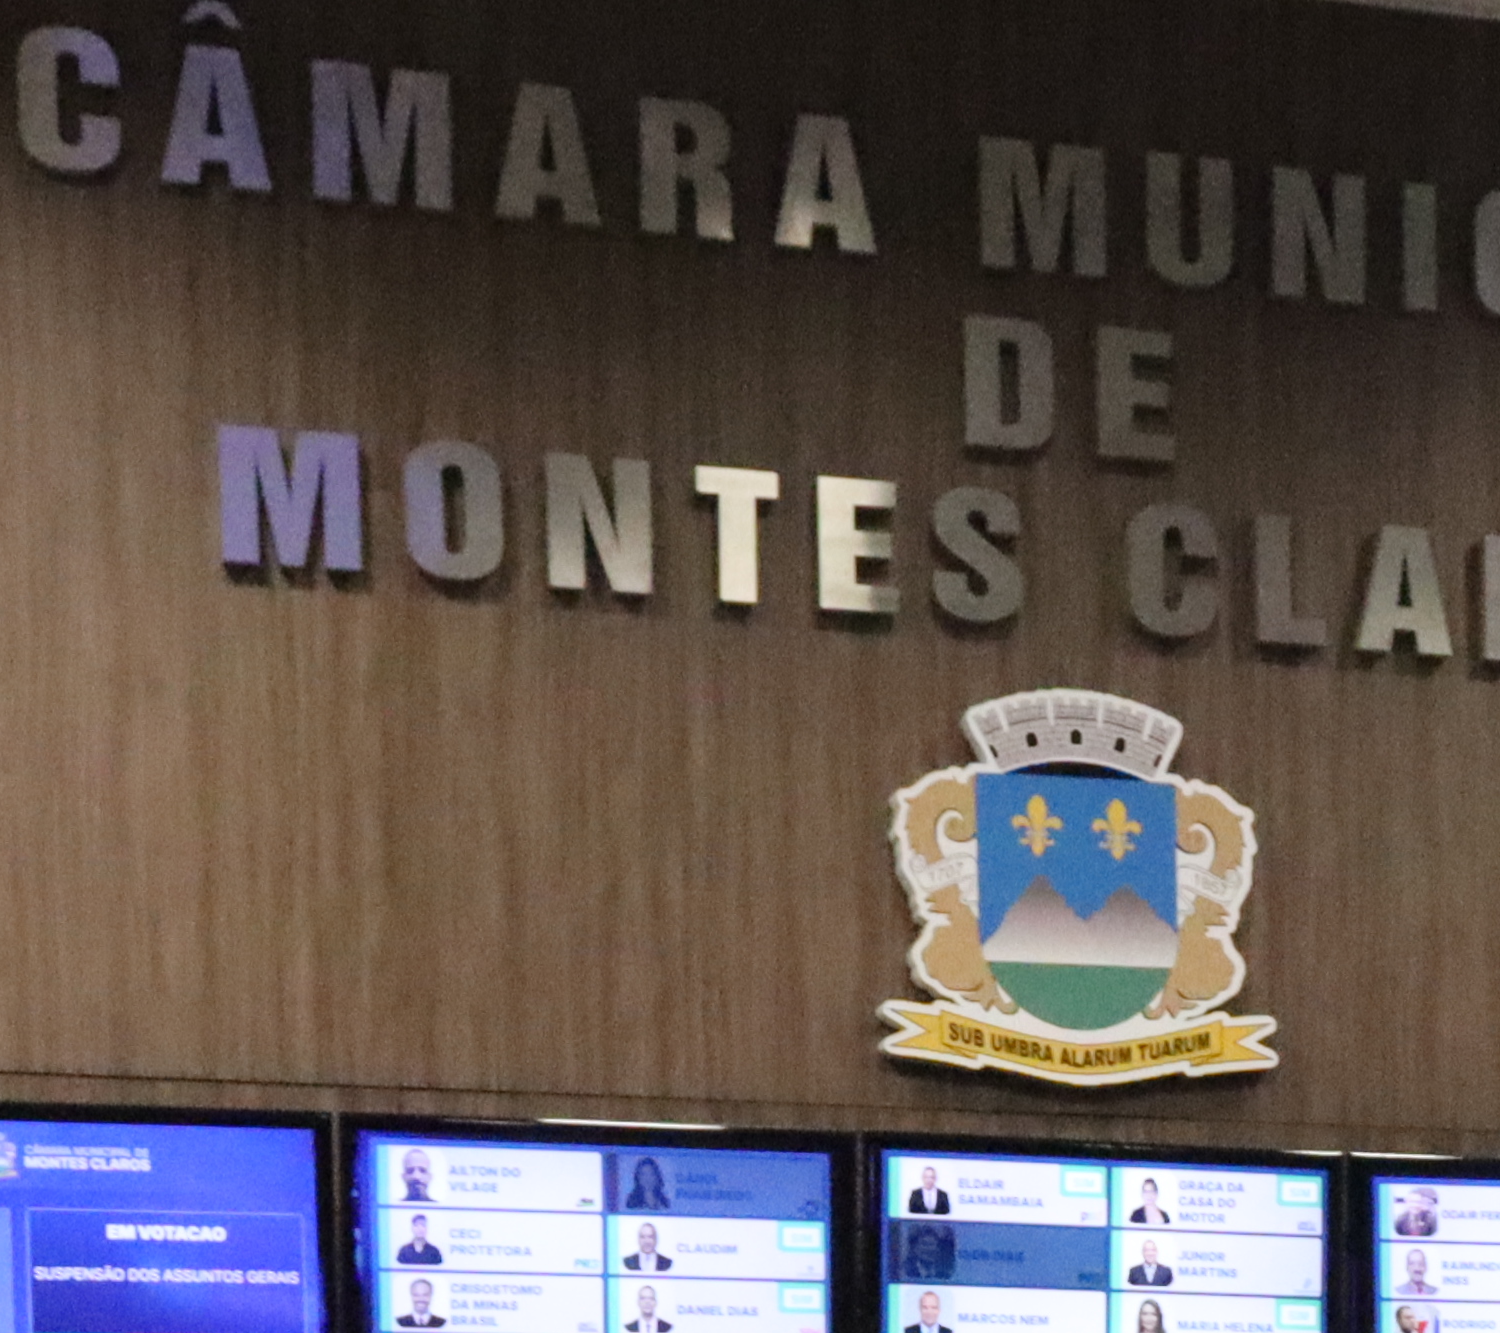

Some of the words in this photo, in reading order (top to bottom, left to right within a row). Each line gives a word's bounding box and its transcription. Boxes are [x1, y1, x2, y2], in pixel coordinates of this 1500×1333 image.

[16, 1, 878, 255] CÂMARA
[962, 314, 1176, 462] DE
[217, 424, 1023, 624] MONTES
[948, 1021, 985, 1049] SUB
[990, 1032, 1054, 1065] UMBRA
[1059, 1038, 1132, 1068] ALARUM
[1137, 1031, 1211, 1062] TUARUM
[24, 1156, 88, 1171] MONTES
[90, 1157, 151, 1172] CLAROS
[449, 1165, 499, 1178] AILTON
[501, 1167, 522, 1178] DO
[958, 1177, 1004, 1190] ELDAIR
[1178, 1180, 1224, 1193] GRAÇA
[1227, 1182, 1245, 1193] DA
[958, 1194, 1043, 1208] SAMAMBAIA
[1178, 1196, 1214, 1208] CASA
[1217, 1197, 1236, 1209] DO
[1178, 1211, 1225, 1224] MOTOR
[106, 1223, 136, 1240] EM
[138, 1224, 227, 1242] VOTACAO
[449, 1244, 533, 1257] PROTETORA
[1177, 1251, 1226, 1263] JUNIOR
[33, 1265, 125, 1282] SUSPENSÃO
[127, 1268, 161, 1282] DOS
[163, 1269, 244, 1284] ASSUNTOS
[246, 1270, 300, 1285] GERAIS
[1177, 1267, 1238, 1279] MARTINS
[451, 1299, 469, 1310] DA
[473, 1300, 519, 1311] MINAS
[677, 1305, 724, 1317] DANIEL
[727, 1306, 759, 1317] DIAS
[958, 1313, 1017, 1326] MARCOS
[1019, 1315, 1050, 1326] NEM
[1177, 1320, 1220, 1332] MARIA
[1223, 1321, 1274, 1333] HELENA
